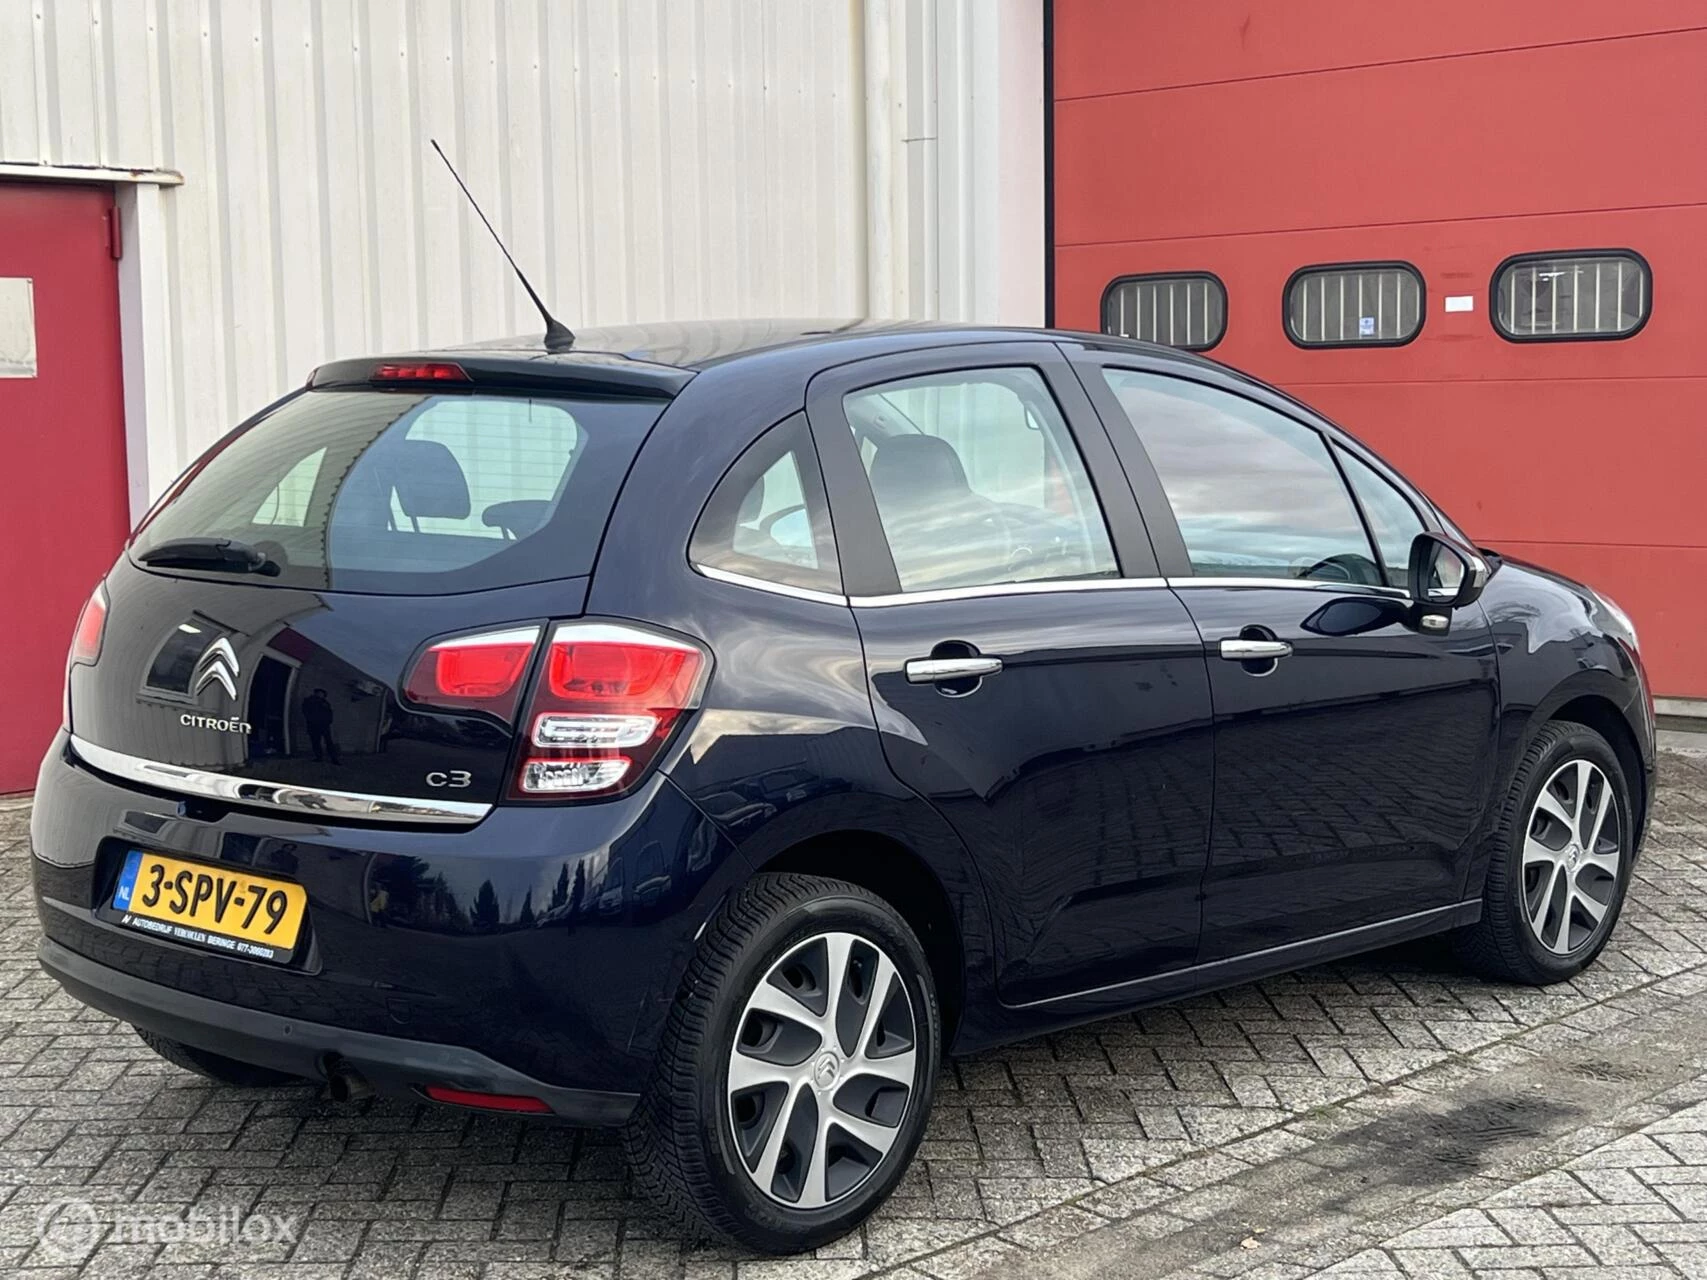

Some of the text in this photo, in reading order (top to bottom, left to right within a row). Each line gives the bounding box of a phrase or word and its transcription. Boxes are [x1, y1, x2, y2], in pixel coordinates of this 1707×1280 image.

[180, 713, 252, 734] CITROËN
[426, 770, 472, 788] C3
[118, 885, 130, 901] NL
[142, 864, 288, 935] 3-SPV-79
